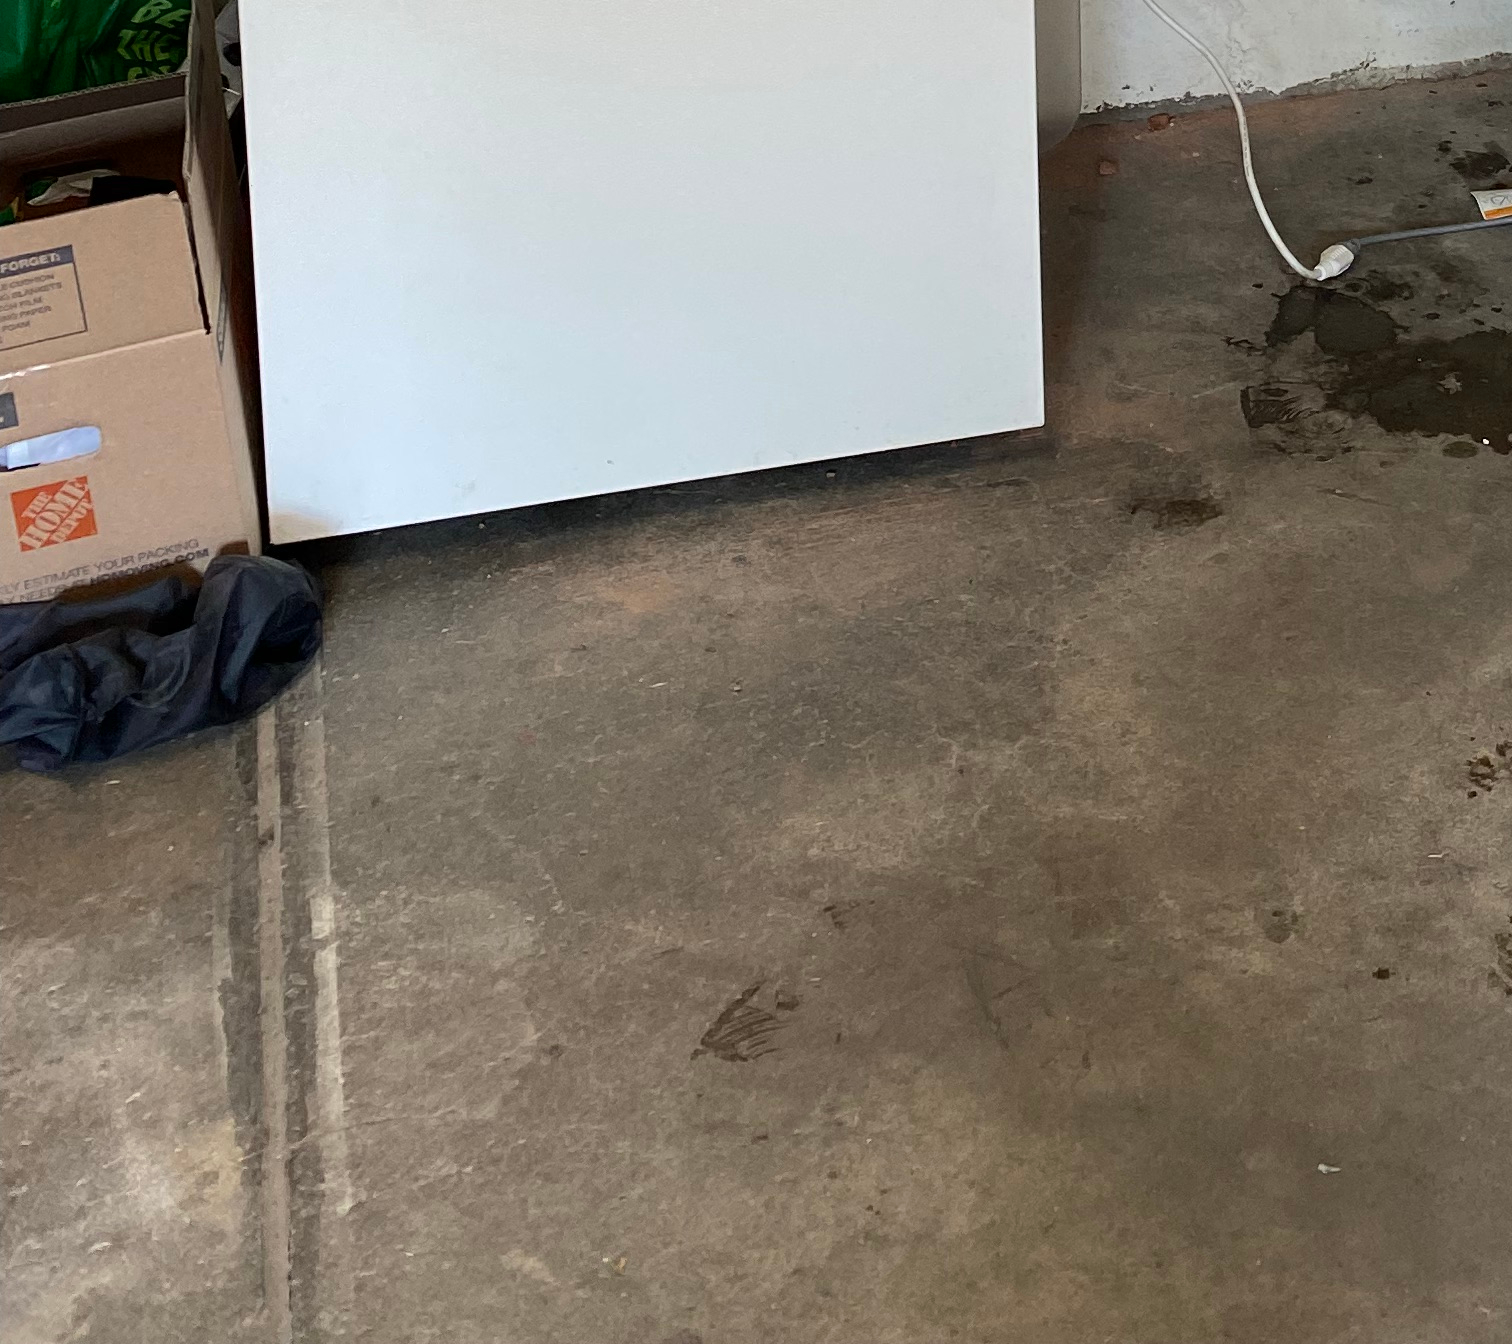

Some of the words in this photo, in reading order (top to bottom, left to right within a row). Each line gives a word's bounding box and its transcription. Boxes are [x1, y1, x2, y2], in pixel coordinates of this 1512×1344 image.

[116, 28, 182, 62] THE
[19, 477, 89, 550] HOME
[21, 491, 53, 520] THE
[49, 498, 94, 545] DEPOT
[23, 564, 90, 590] ESTIMATE
[94, 554, 136, 572] YOUR
[137, 537, 200, 563] PACKING
